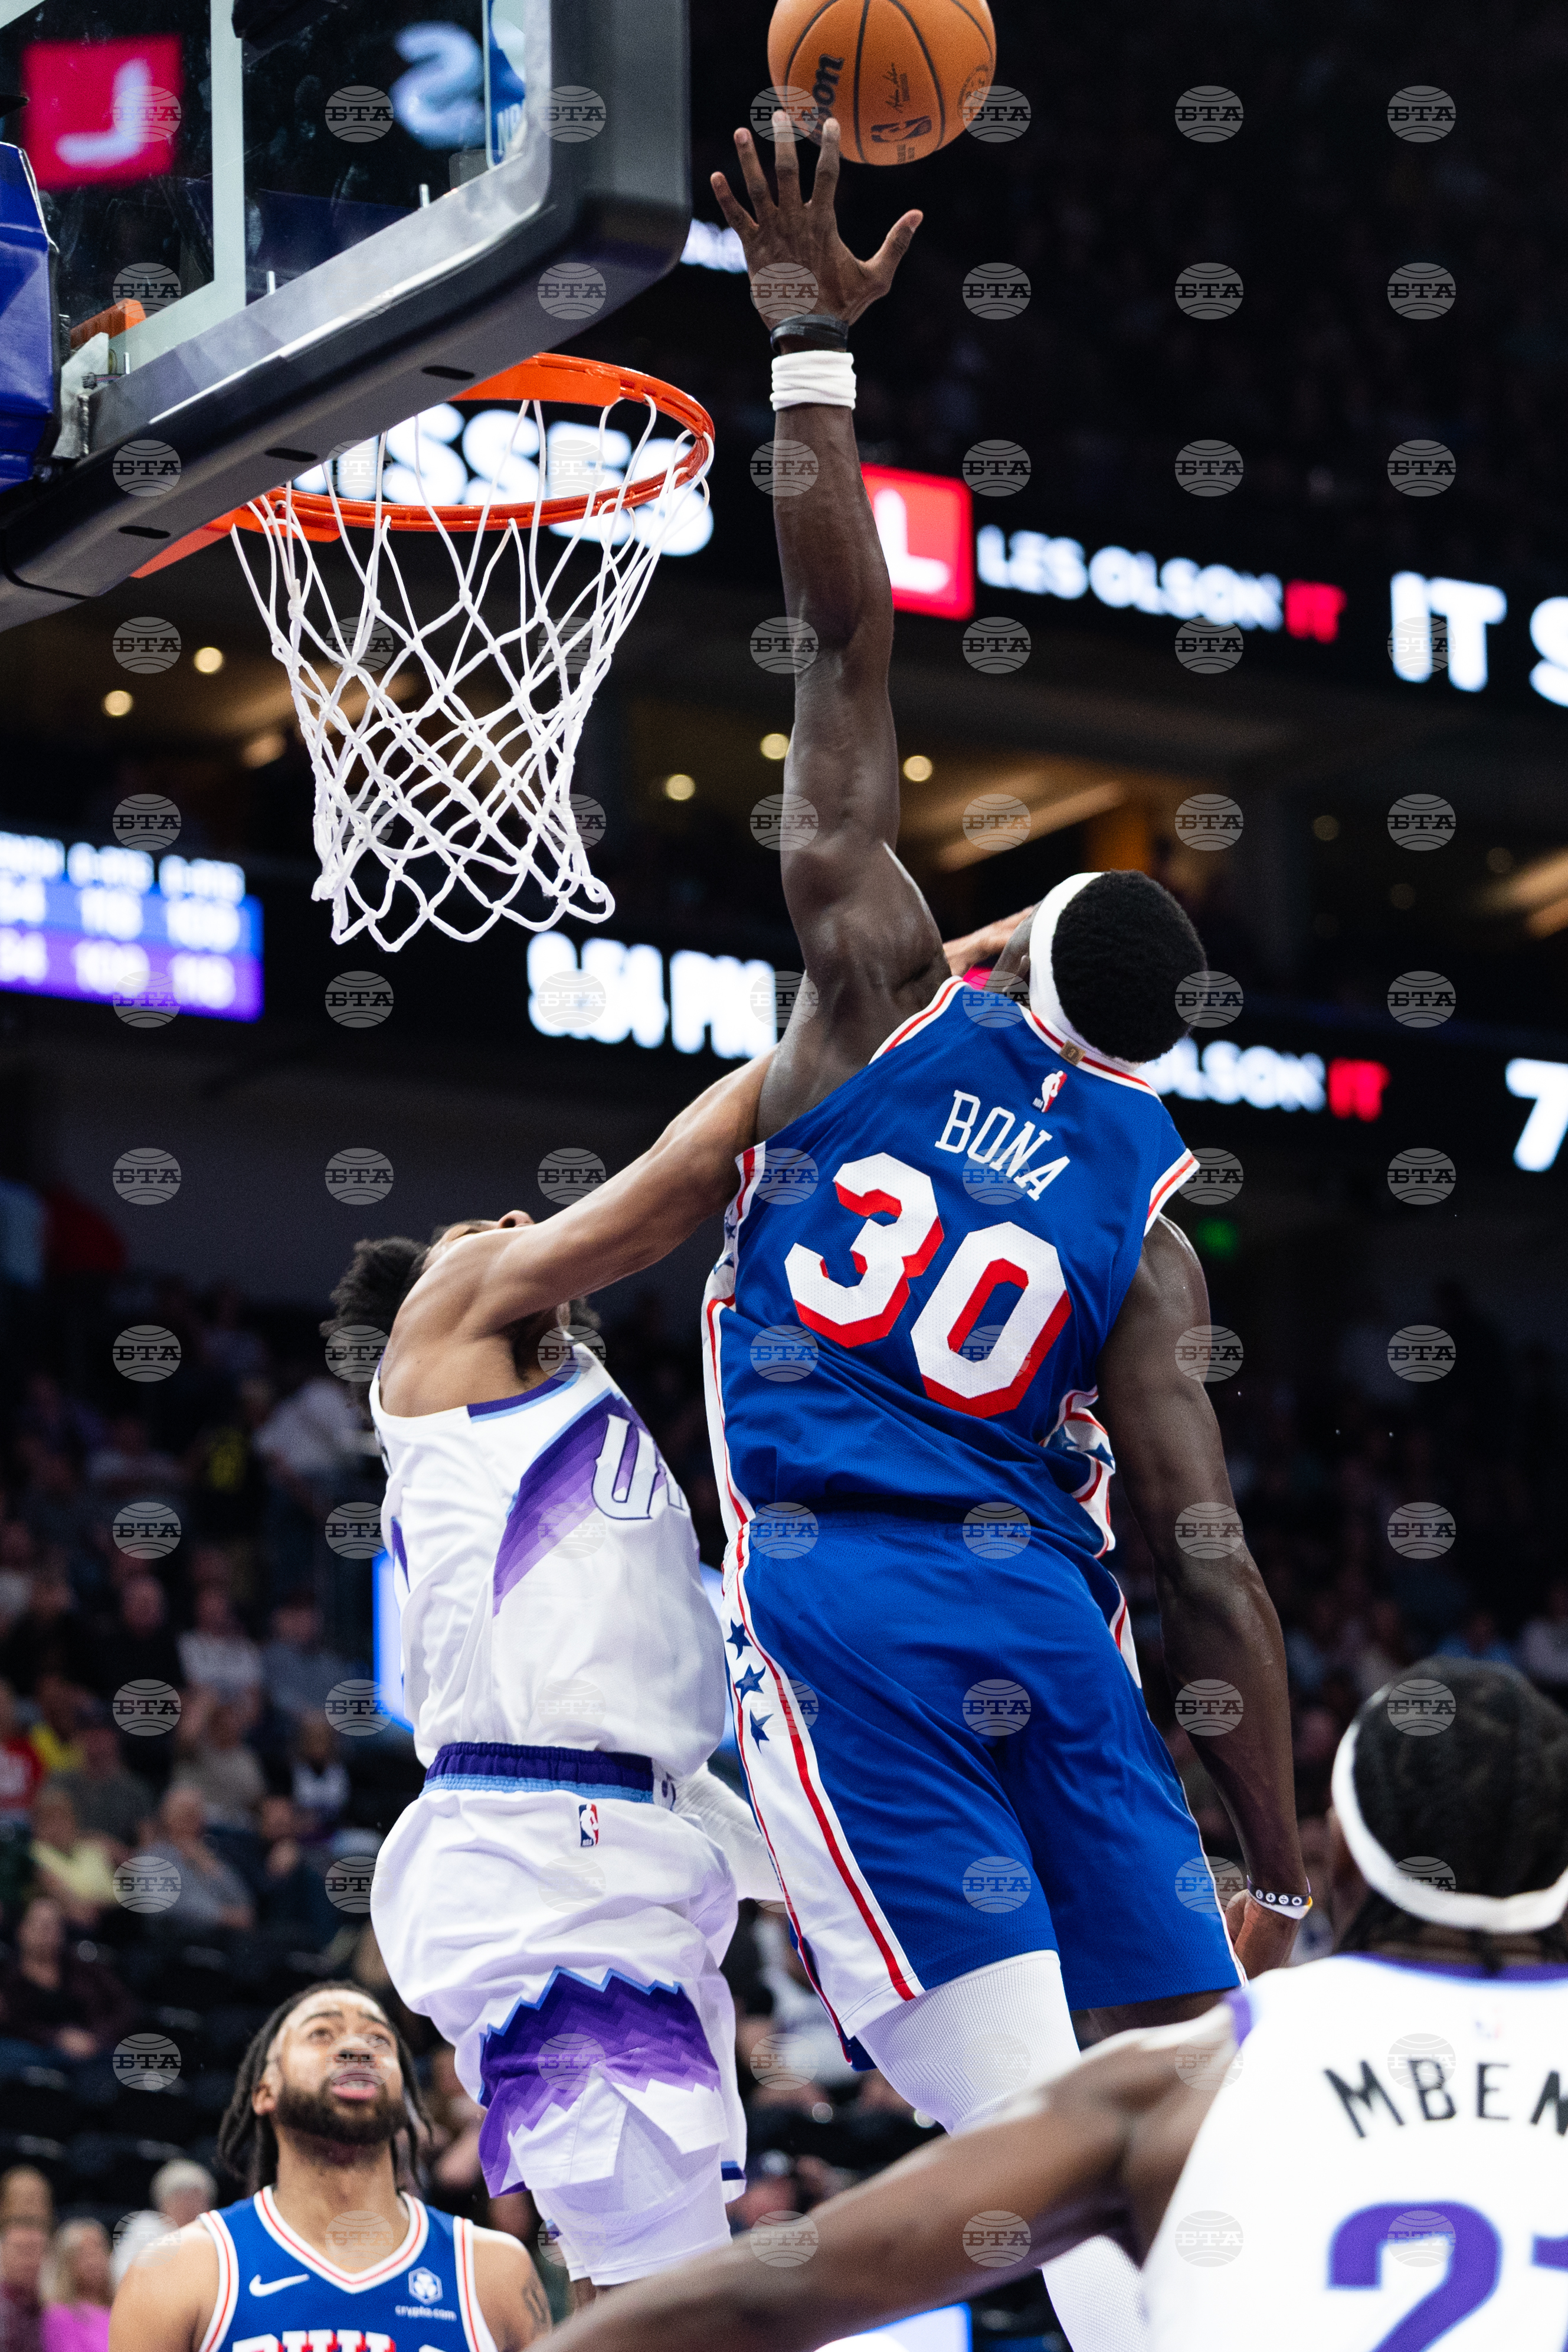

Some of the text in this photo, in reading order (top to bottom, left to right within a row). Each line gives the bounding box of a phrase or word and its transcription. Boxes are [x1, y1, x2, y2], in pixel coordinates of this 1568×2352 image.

[977, 524, 1088, 599] LES
[1089, 545, 1284, 632] OLSON
[1136, 1037, 1327, 1112] LSON
[935, 1090, 1071, 1202] BONA
[785, 1152, 1072, 1418] 30
